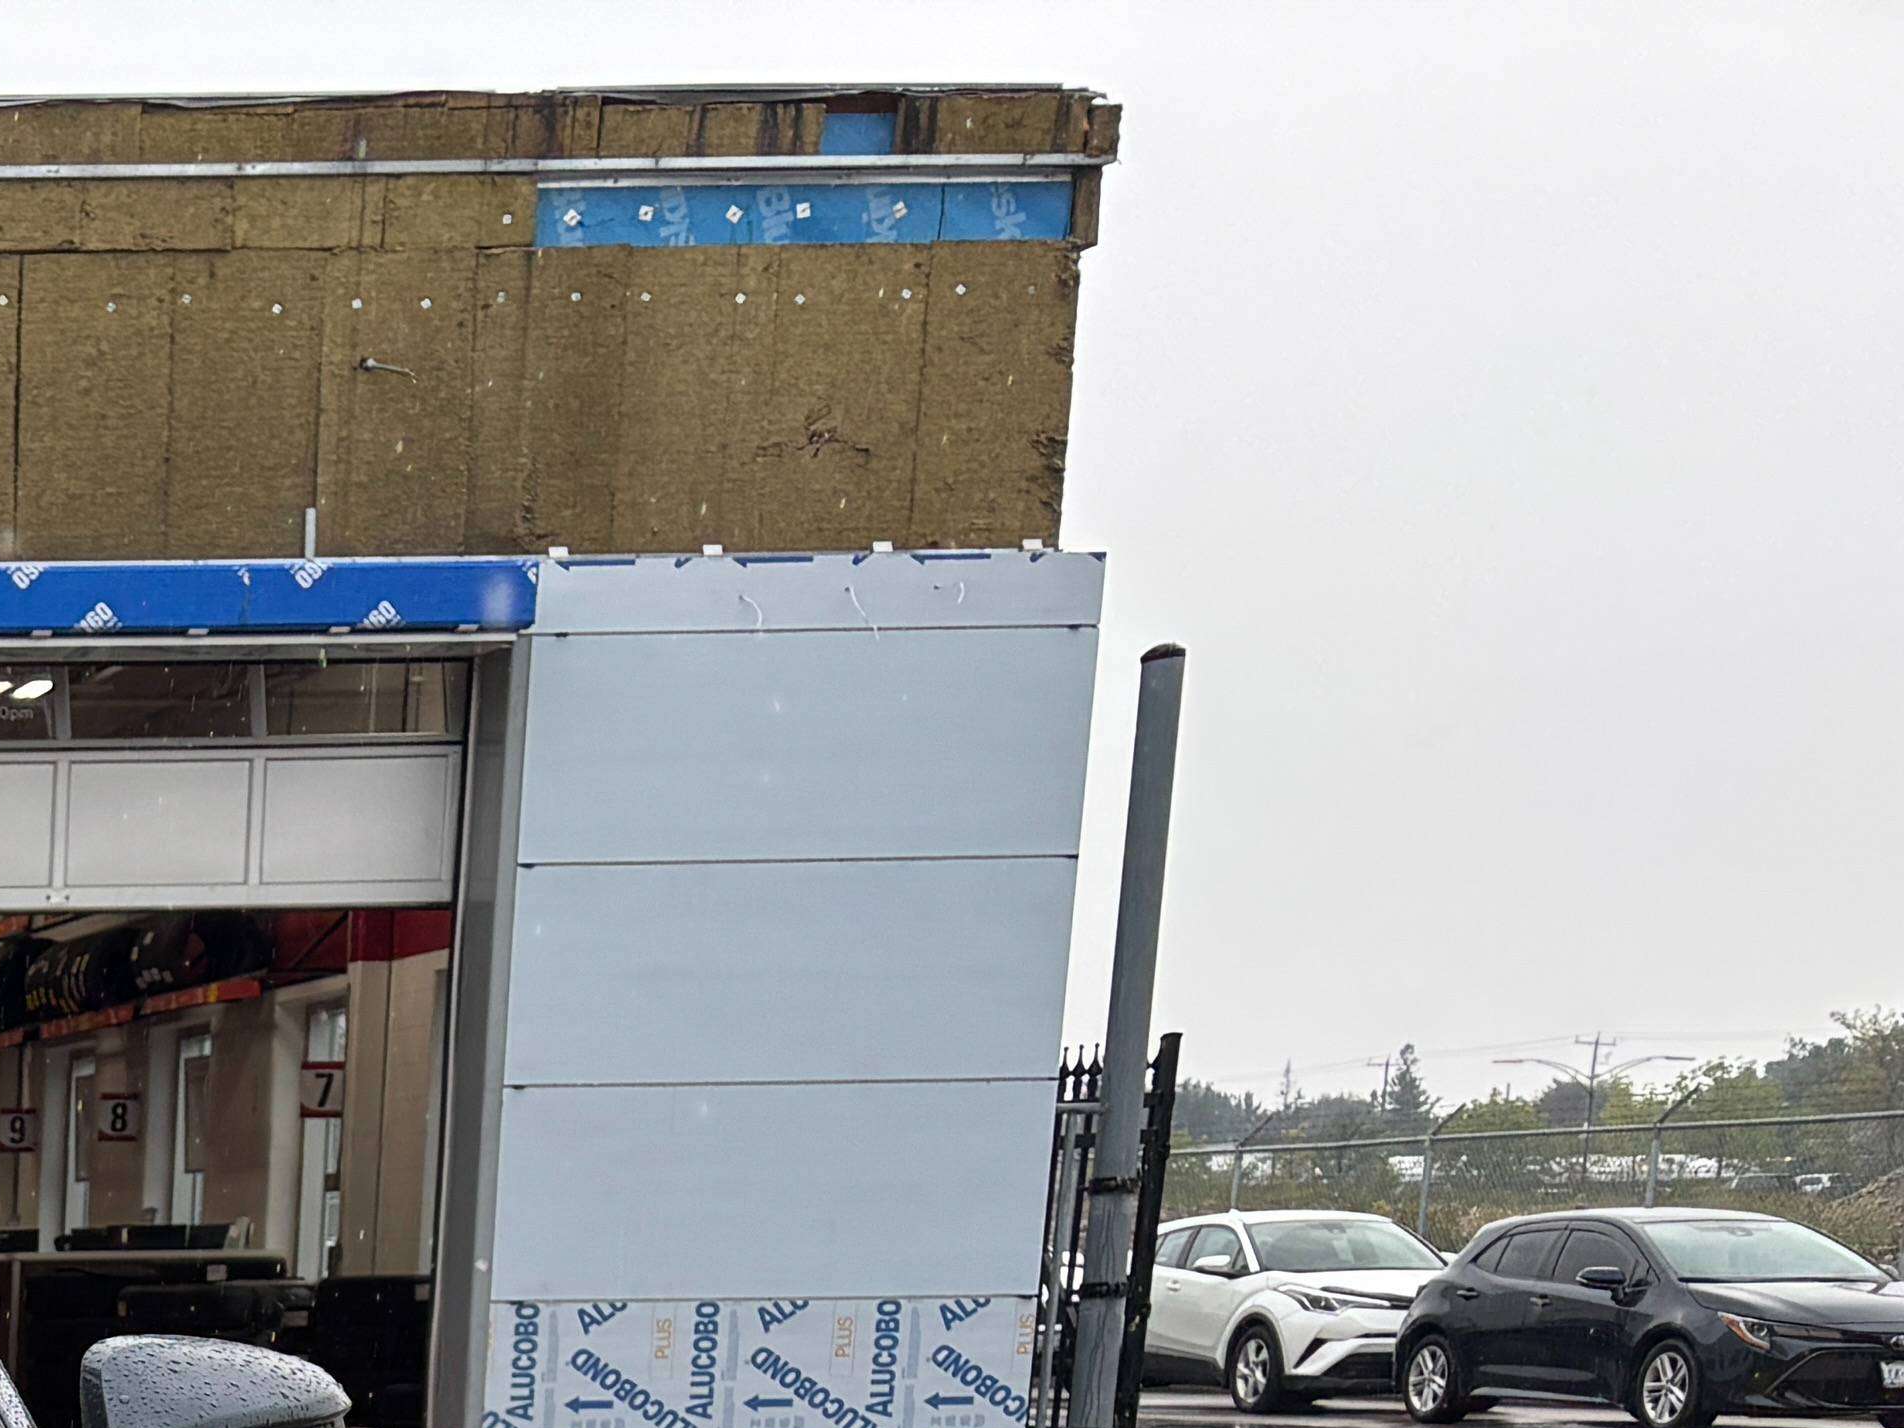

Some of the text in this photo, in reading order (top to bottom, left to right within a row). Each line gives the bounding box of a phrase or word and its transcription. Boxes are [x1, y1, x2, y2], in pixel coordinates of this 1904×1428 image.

[315, 1073, 334, 1108] 7
[10, 1117, 25, 1144] 9
[111, 1103, 127, 1132] 8
[655, 1318, 673, 1359] PLUS
[835, 1316, 853, 1358] PLUS
[1016, 1313, 1035, 1356] PLUS
